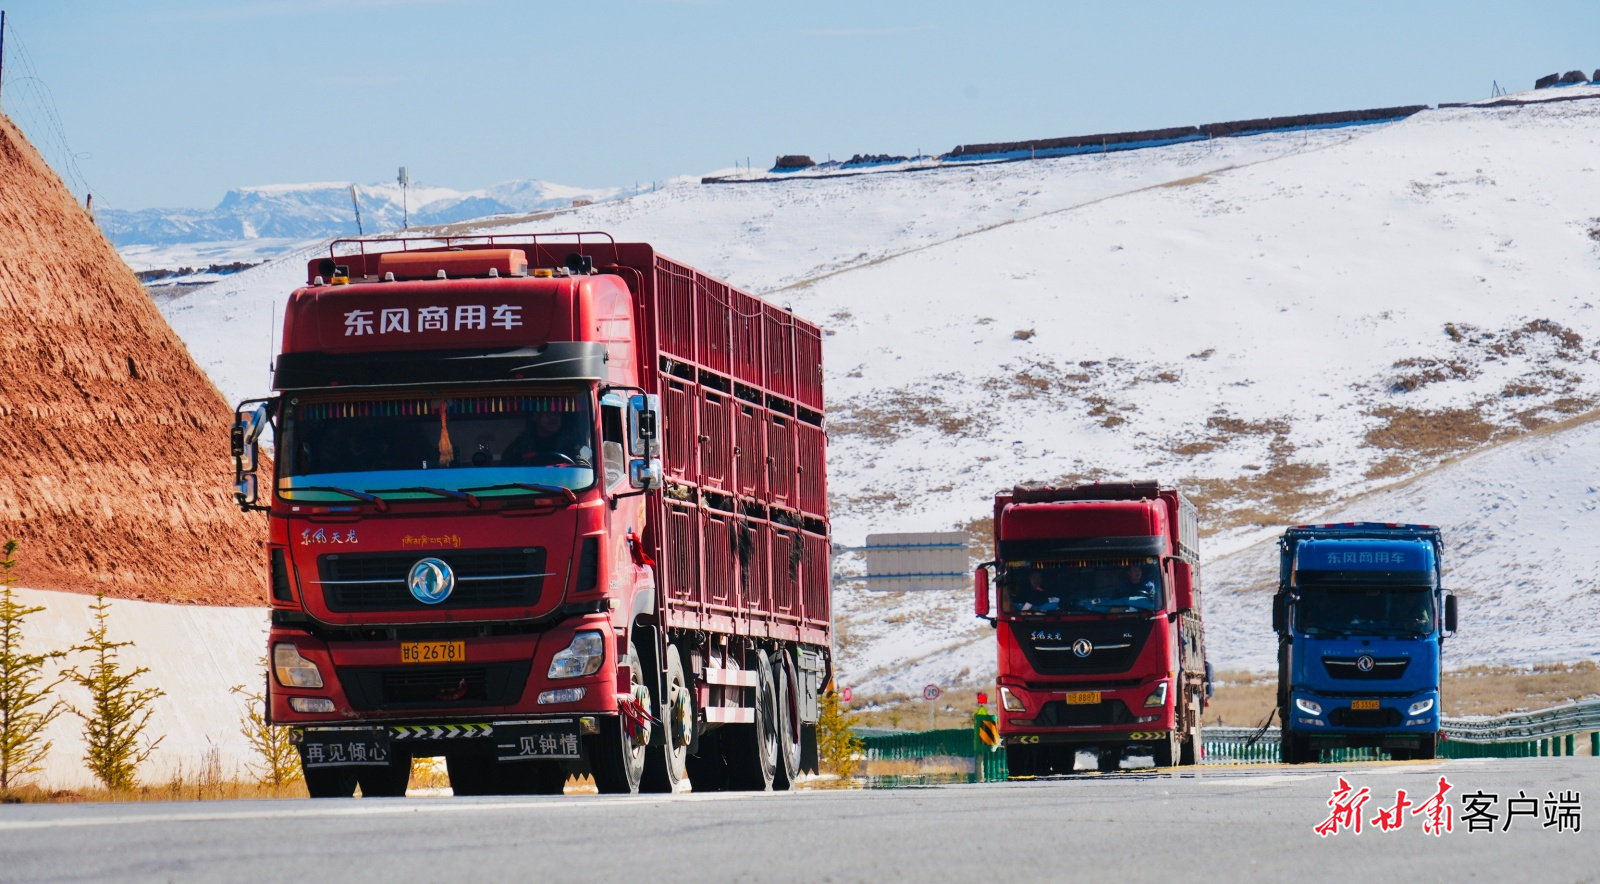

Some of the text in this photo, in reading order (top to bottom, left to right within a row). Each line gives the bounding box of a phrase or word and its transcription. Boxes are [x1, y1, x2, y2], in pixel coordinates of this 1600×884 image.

[344, 304, 523, 336] 东风商用车
[1327, 551, 1405, 564] 东风商用车
[306, 742, 388, 762] 再见倾心
[497, 733, 579, 756] 一见钟情
